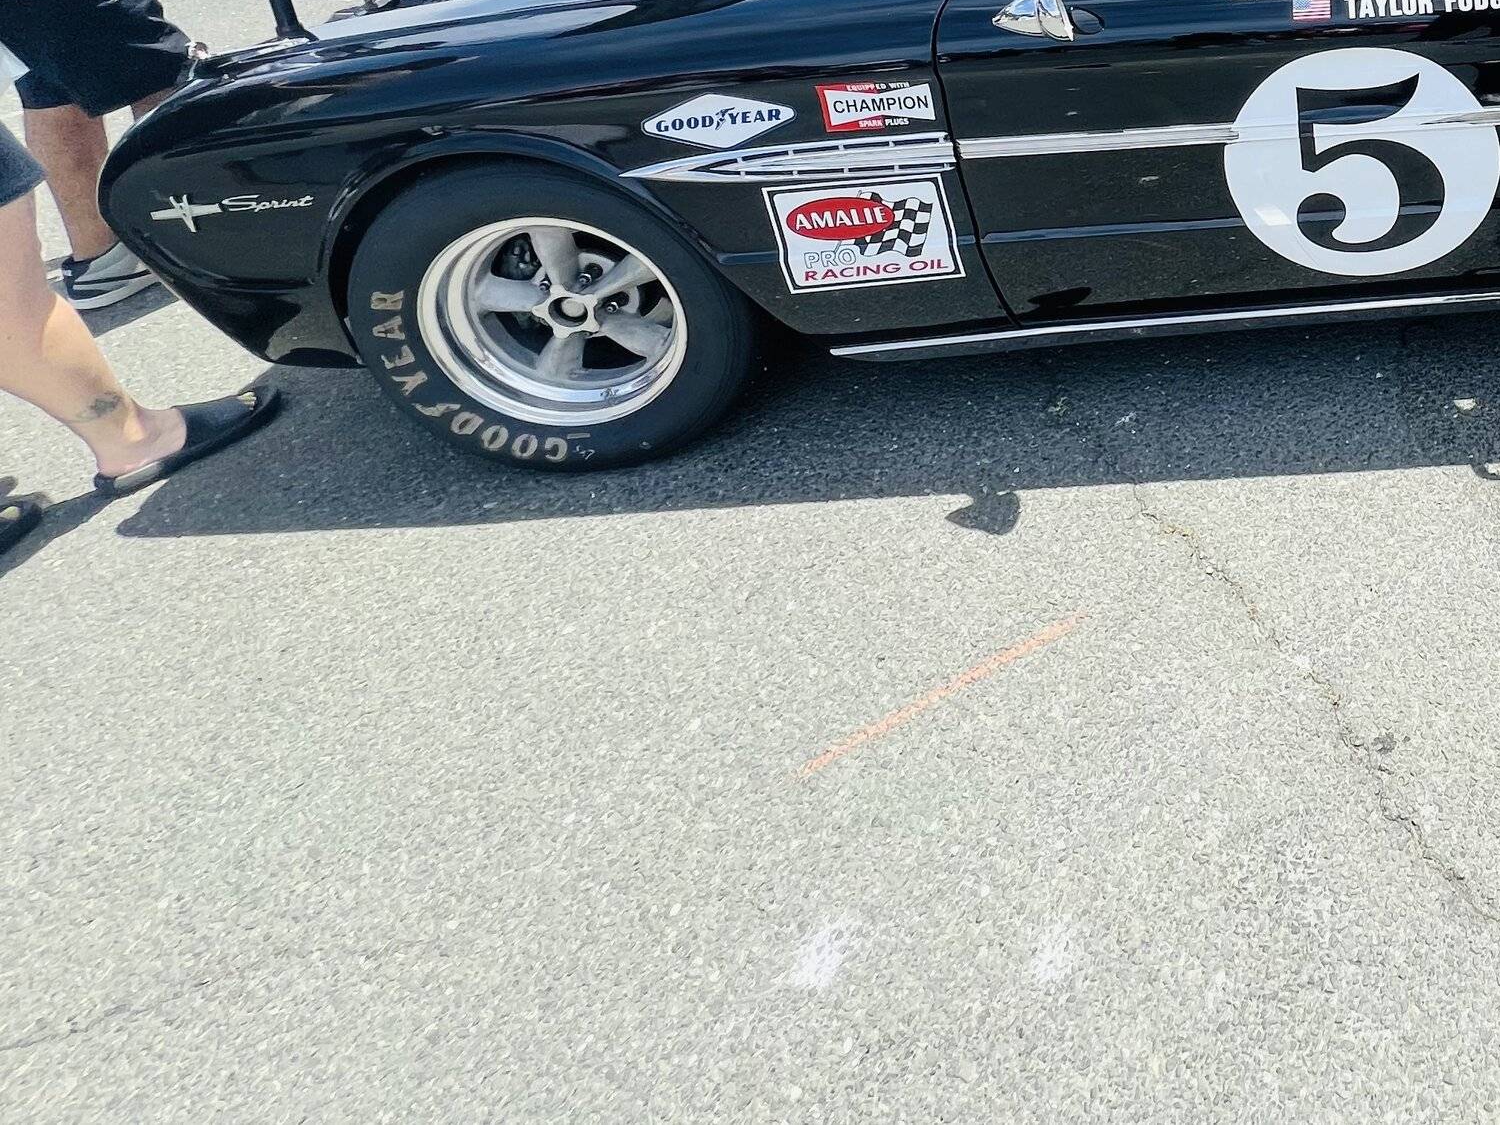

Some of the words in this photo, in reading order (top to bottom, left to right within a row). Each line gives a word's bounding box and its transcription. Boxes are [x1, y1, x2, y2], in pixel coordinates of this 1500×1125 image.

[889, 81, 910, 89] WITH
[832, 95, 929, 114] CHAMPION
[655, 107, 782, 133] GOODYEAR
[858, 119, 883, 128] SPARK
[885, 117, 910, 126] PLUGS
[1296, 72, 1446, 253] 5
[222, 194, 314, 213] Sprint
[795, 207, 889, 231] AMALIE
[804, 249, 856, 269] PRO
[804, 263, 901, 281] RACING
[908, 259, 949, 272] OIL
